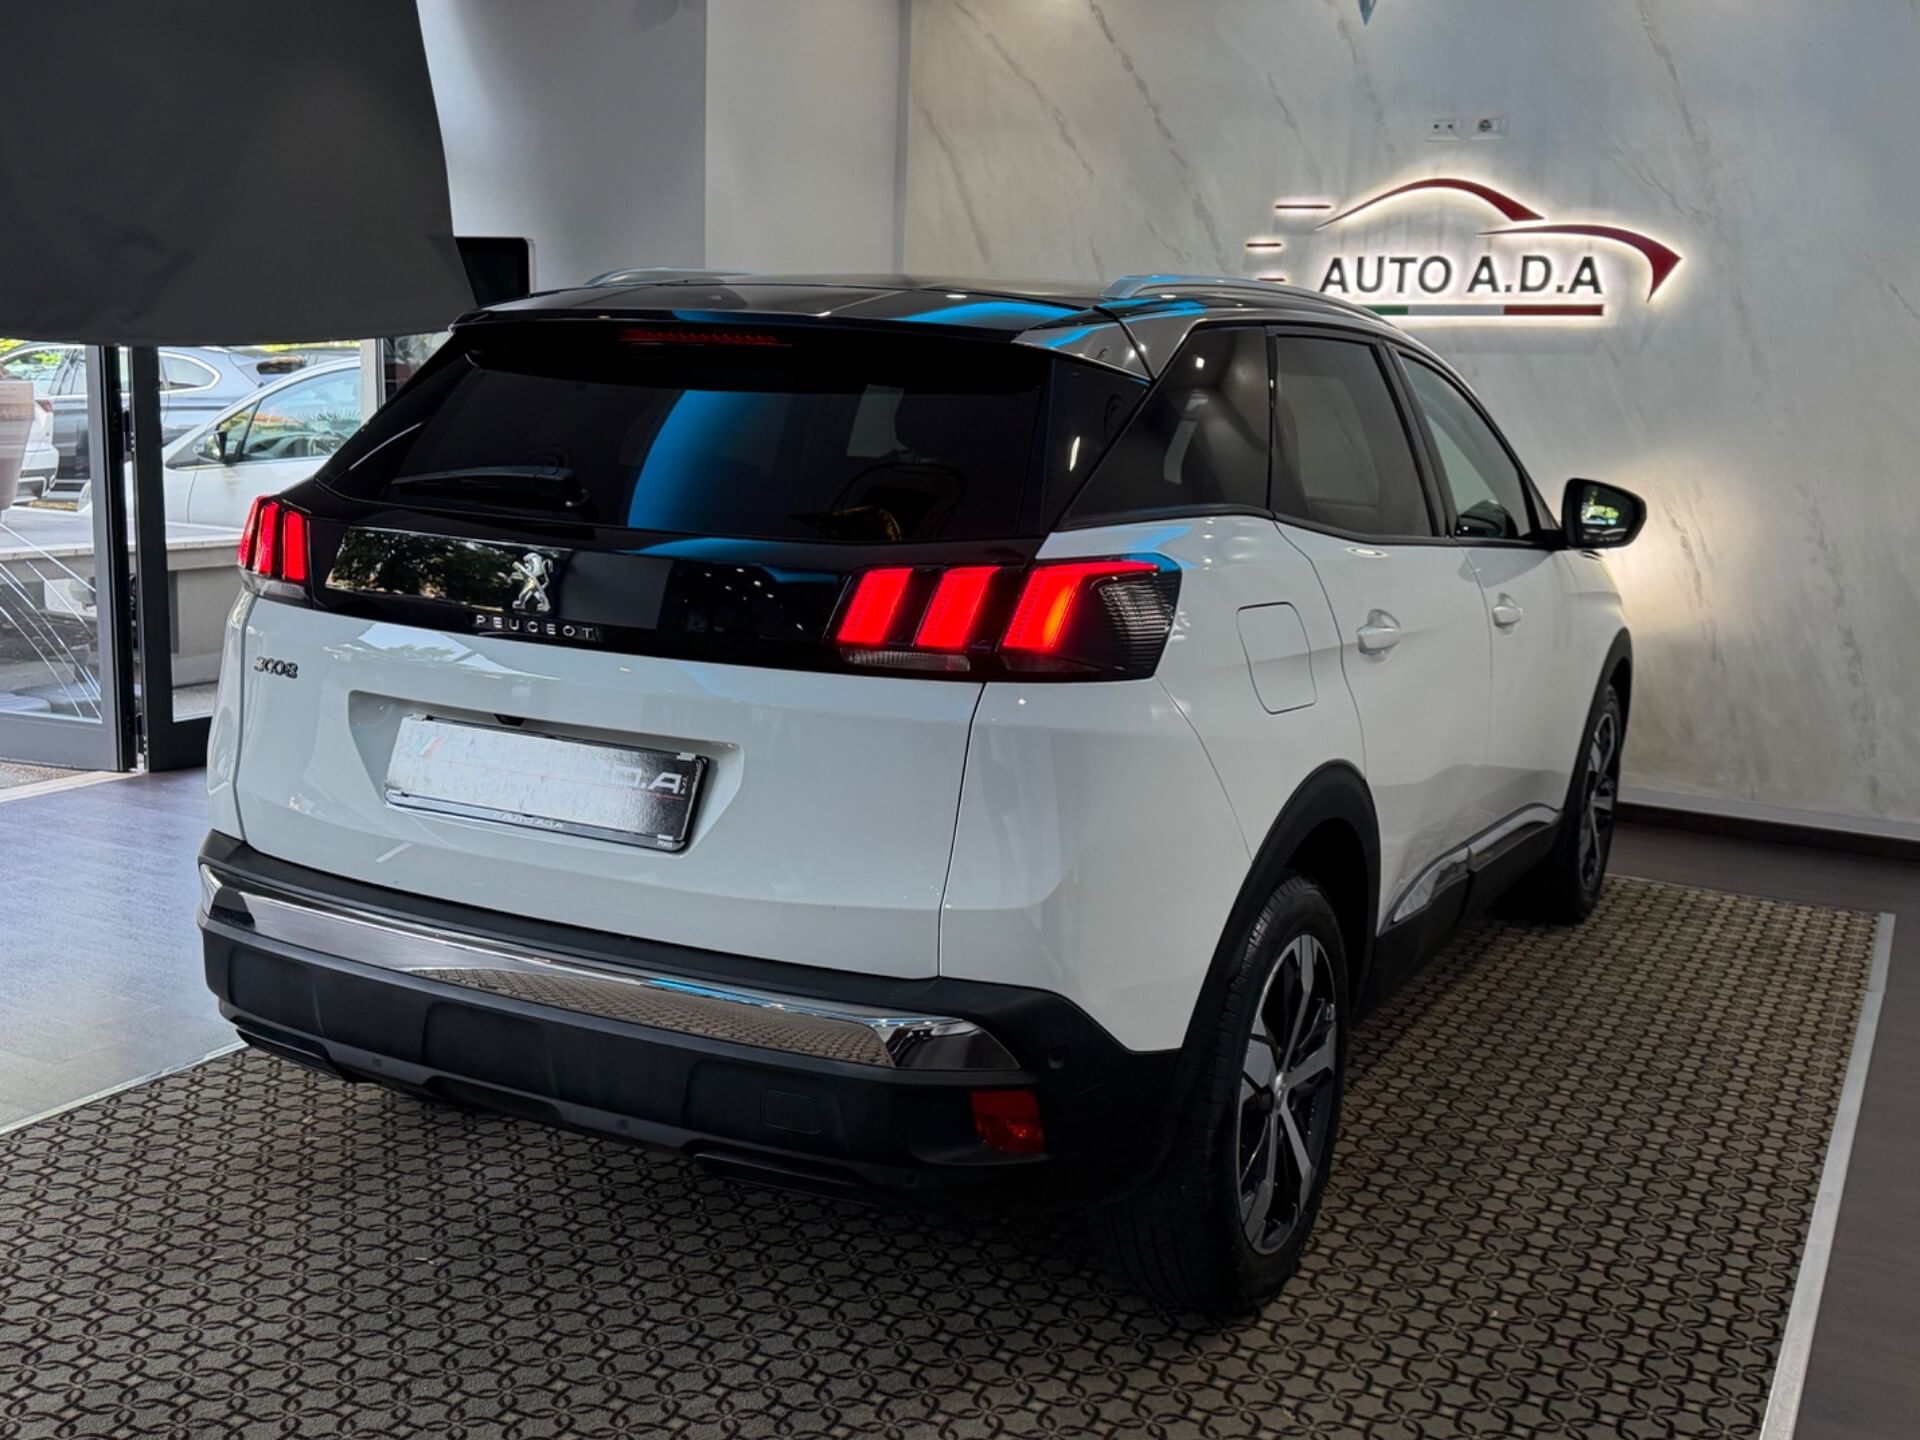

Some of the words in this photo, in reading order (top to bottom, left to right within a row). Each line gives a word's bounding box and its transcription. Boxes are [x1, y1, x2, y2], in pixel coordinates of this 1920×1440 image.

[1319, 255, 1452, 293] AUTO
[1466, 255, 1604, 294] A.D.A
[476, 614, 594, 639] PEUGEOT
[253, 655, 299, 680] 3008
